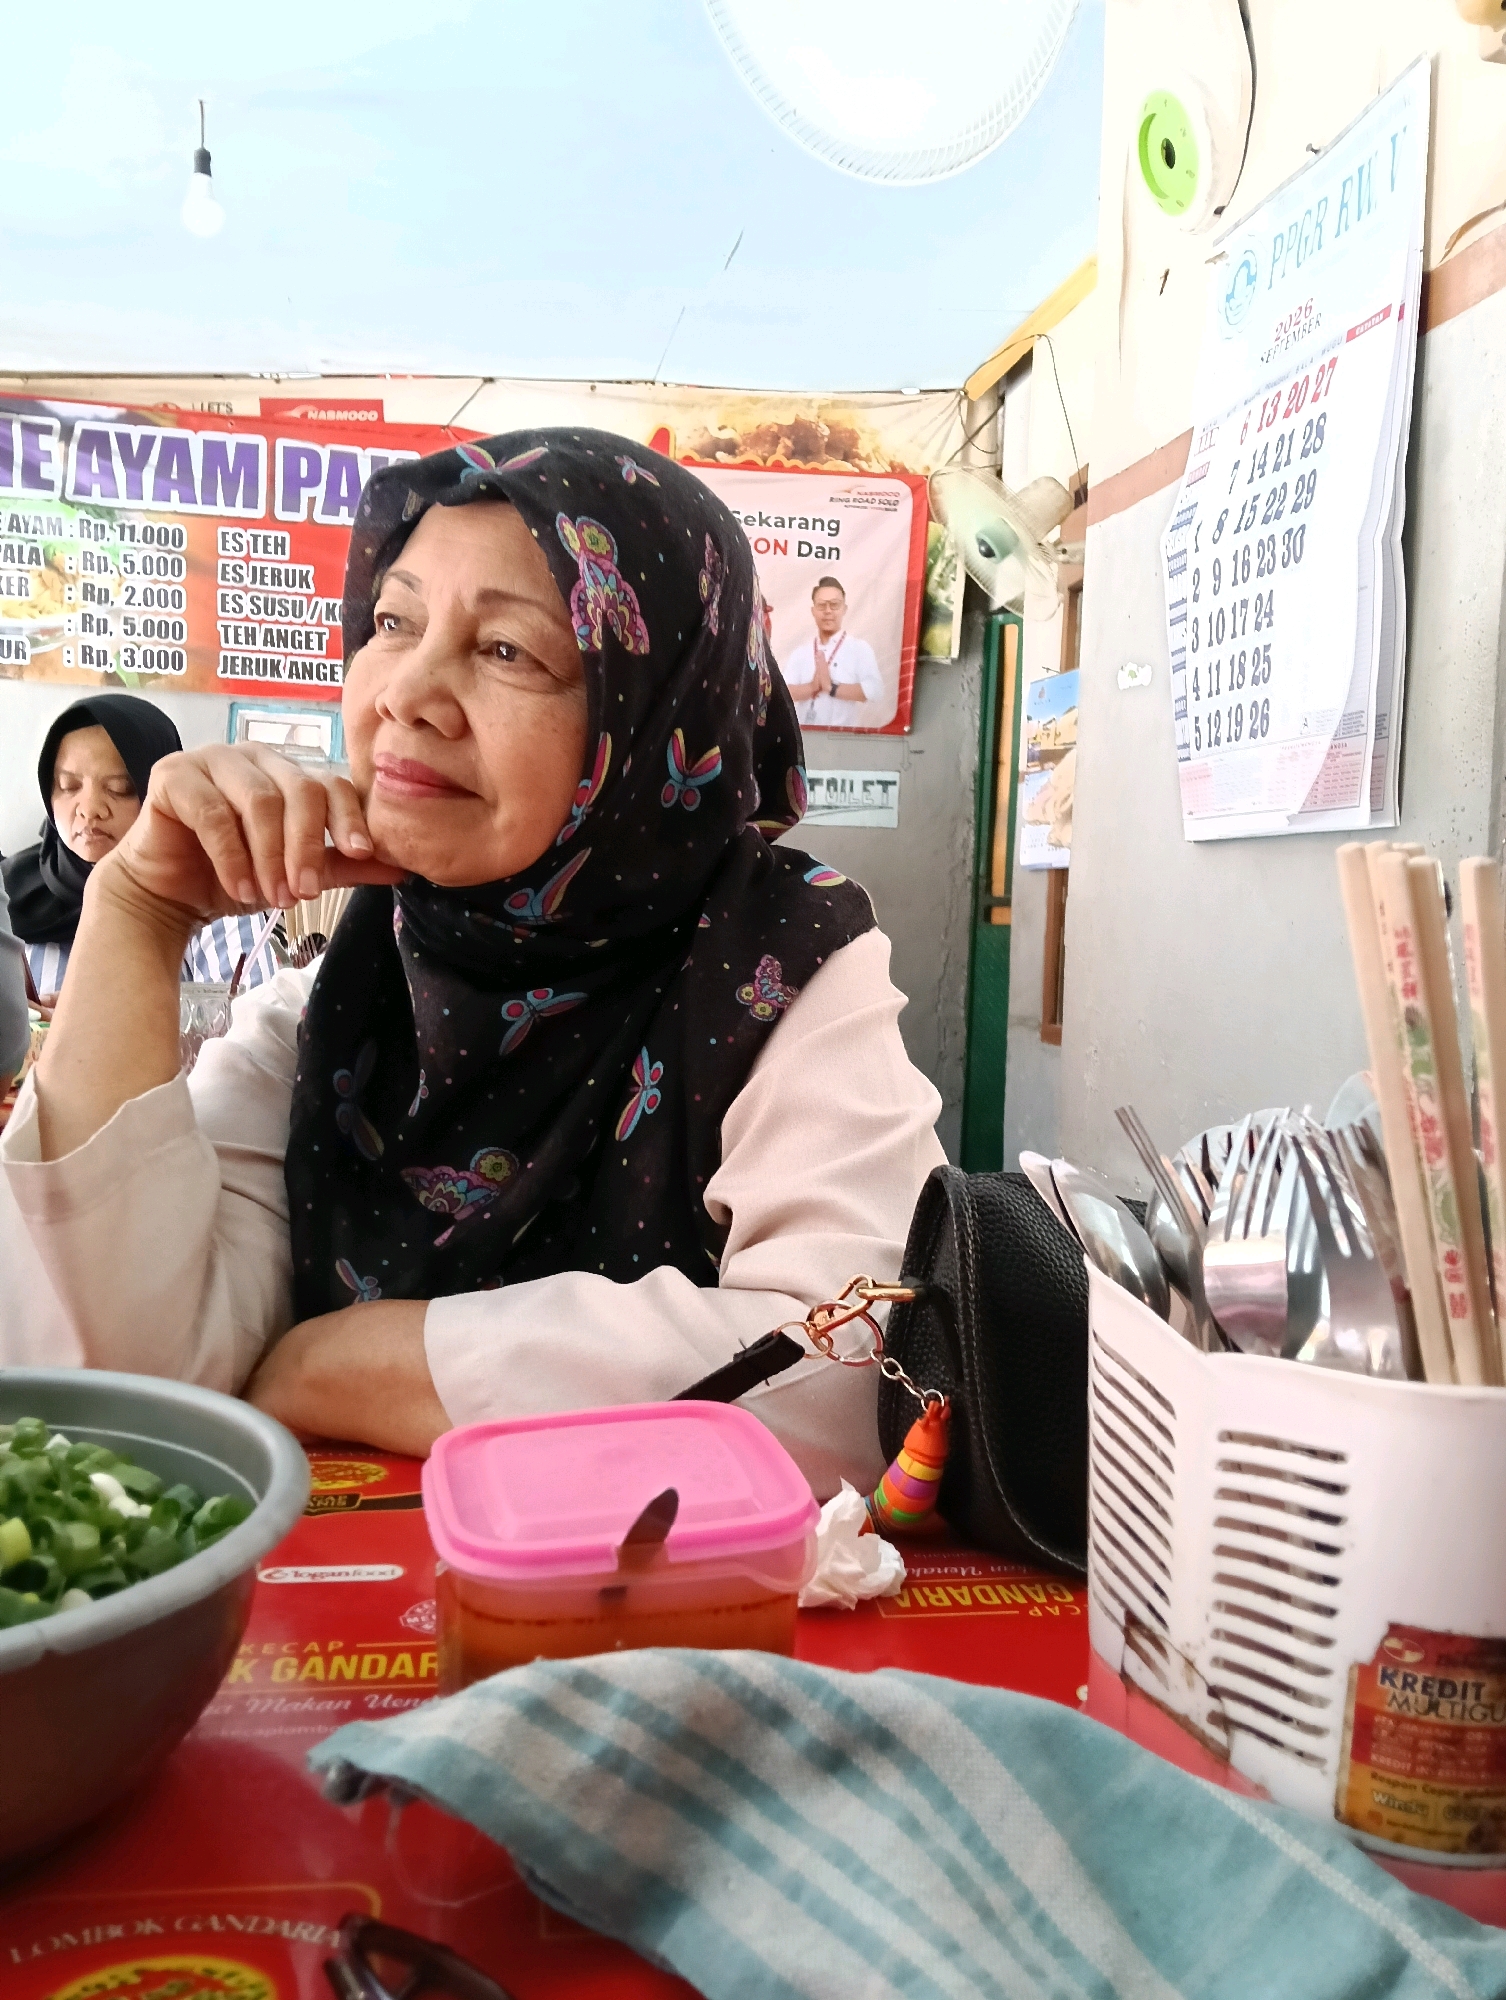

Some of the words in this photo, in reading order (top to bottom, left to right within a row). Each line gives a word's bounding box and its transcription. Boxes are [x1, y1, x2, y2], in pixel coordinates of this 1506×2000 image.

[1273, 298, 1313, 342] 2026
[1260, 312, 1321, 367] SEPTEMBER
[1240, 409, 1251, 446] 6
[1257, 390, 1281, 433] 13
[1282, 374, 1309, 420] 20
[1311, 356, 1338, 404] 27
[1229, 460, 1241, 495] 7
[1247, 441, 1269, 485] 14
[1272, 428, 1295, 474] 21
[1300, 412, 1327, 460] 28
[72, 428, 259, 510] AYAM
[281, 445, 420, 518] PA
[1195, 520, 1203, 553] 1
[1212, 508, 1229, 544] 8
[1233, 493, 1261, 534] 15
[1261, 481, 1287, 525] 22
[1290, 468, 1317, 514] 29
[8, 513, 63, 537] AYAM
[118, 522, 184, 549] 11.000
[221, 531, 244, 553] ES
[250, 533, 287, 556] TEH
[797, 540, 840, 560] Dan
[1193, 567, 1201, 603] 2
[1212, 557, 1222, 596] 9
[1232, 544, 1251, 587] 16
[1256, 533, 1277, 578] 23
[1281, 523, 1306, 569] 30
[123, 553, 183, 578] 5.000
[221, 563, 244, 584] ES
[250, 565, 312, 590] JERUK
[124, 585, 183, 610] 2.000
[221, 593, 244, 614] ES
[250, 595, 304, 619] SUSU
[123, 616, 184, 642] 5.000
[1192, 616, 1200, 653] 3
[1207, 607, 1226, 648] 10
[1230, 597, 1250, 640] 17
[1254, 589, 1274, 632] 24
[221, 624, 257, 647] TEH
[263, 627, 327, 652] ANGET
[123, 647, 184, 672] 3.000
[221, 655, 283, 679] JERUK
[288, 660, 342, 683] ANGE
[1192, 666, 1201, 702] 4
[1207, 659, 1221, 698] 11
[1228, 650, 1247, 691] 18
[1251, 643, 1272, 686] 25
[1194, 716, 1202, 752] 5
[1207, 709, 1222, 748] 12
[1226, 702, 1244, 743] 19
[1249, 697, 1270, 740] 26
[808, 777, 897, 806] TOILET
[896, 1582, 1075, 1608] GANDARIA
[1028, 1604, 1085, 1617] CAP
[238, 1640, 344, 1655] KECAP
[270, 1652, 438, 1683] GANDAR
[1380, 1665, 1486, 1702] KREDIT
[10, 1917, 164, 1964] LOMBOK
